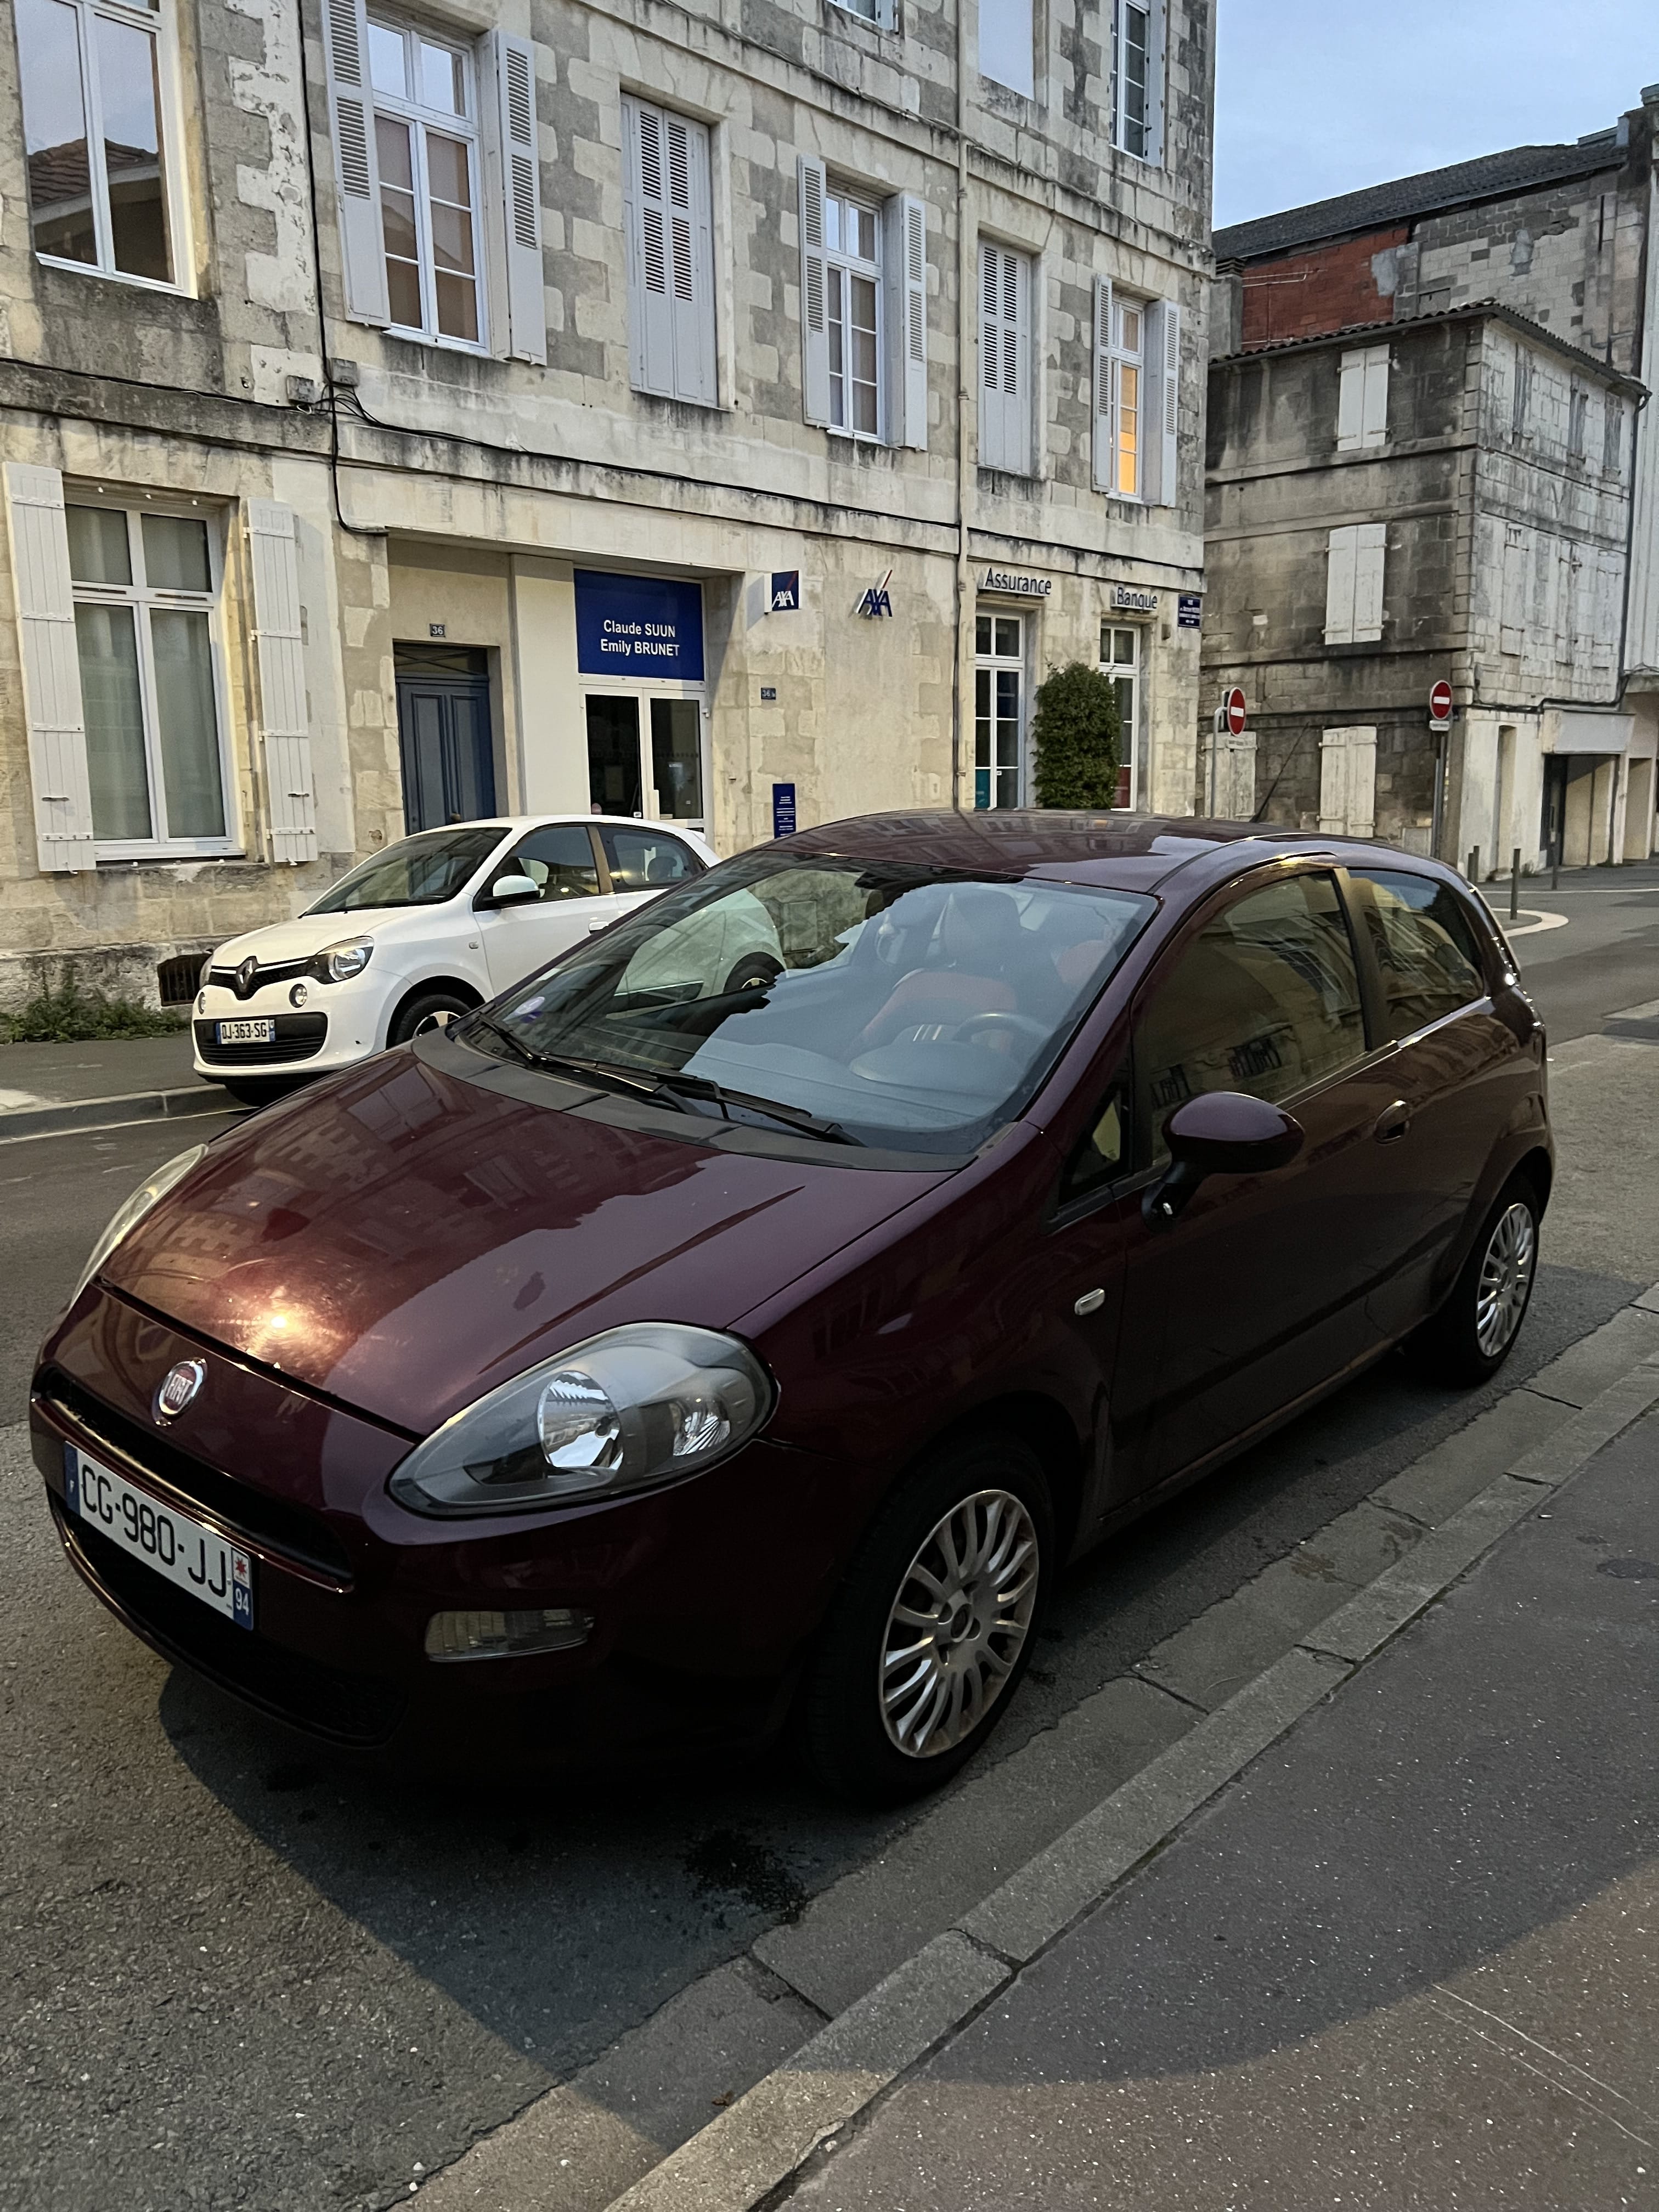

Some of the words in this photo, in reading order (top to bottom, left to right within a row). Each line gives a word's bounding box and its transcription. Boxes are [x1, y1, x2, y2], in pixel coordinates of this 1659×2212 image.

[985, 567, 1052, 595] Assurance
[771, 590, 794, 607] AXA
[856, 588, 893, 617] AXA
[1118, 586, 1157, 611] Banque
[432, 626, 443, 635] 36
[603, 619, 642, 635] Claude
[645, 623, 675, 637] SUUN
[601, 639, 631, 656] Emily
[634, 641, 680, 656] BRUNET
[82, 1464, 227, 1598] CG-980-JJ
[235, 1587, 250, 1616] 94
